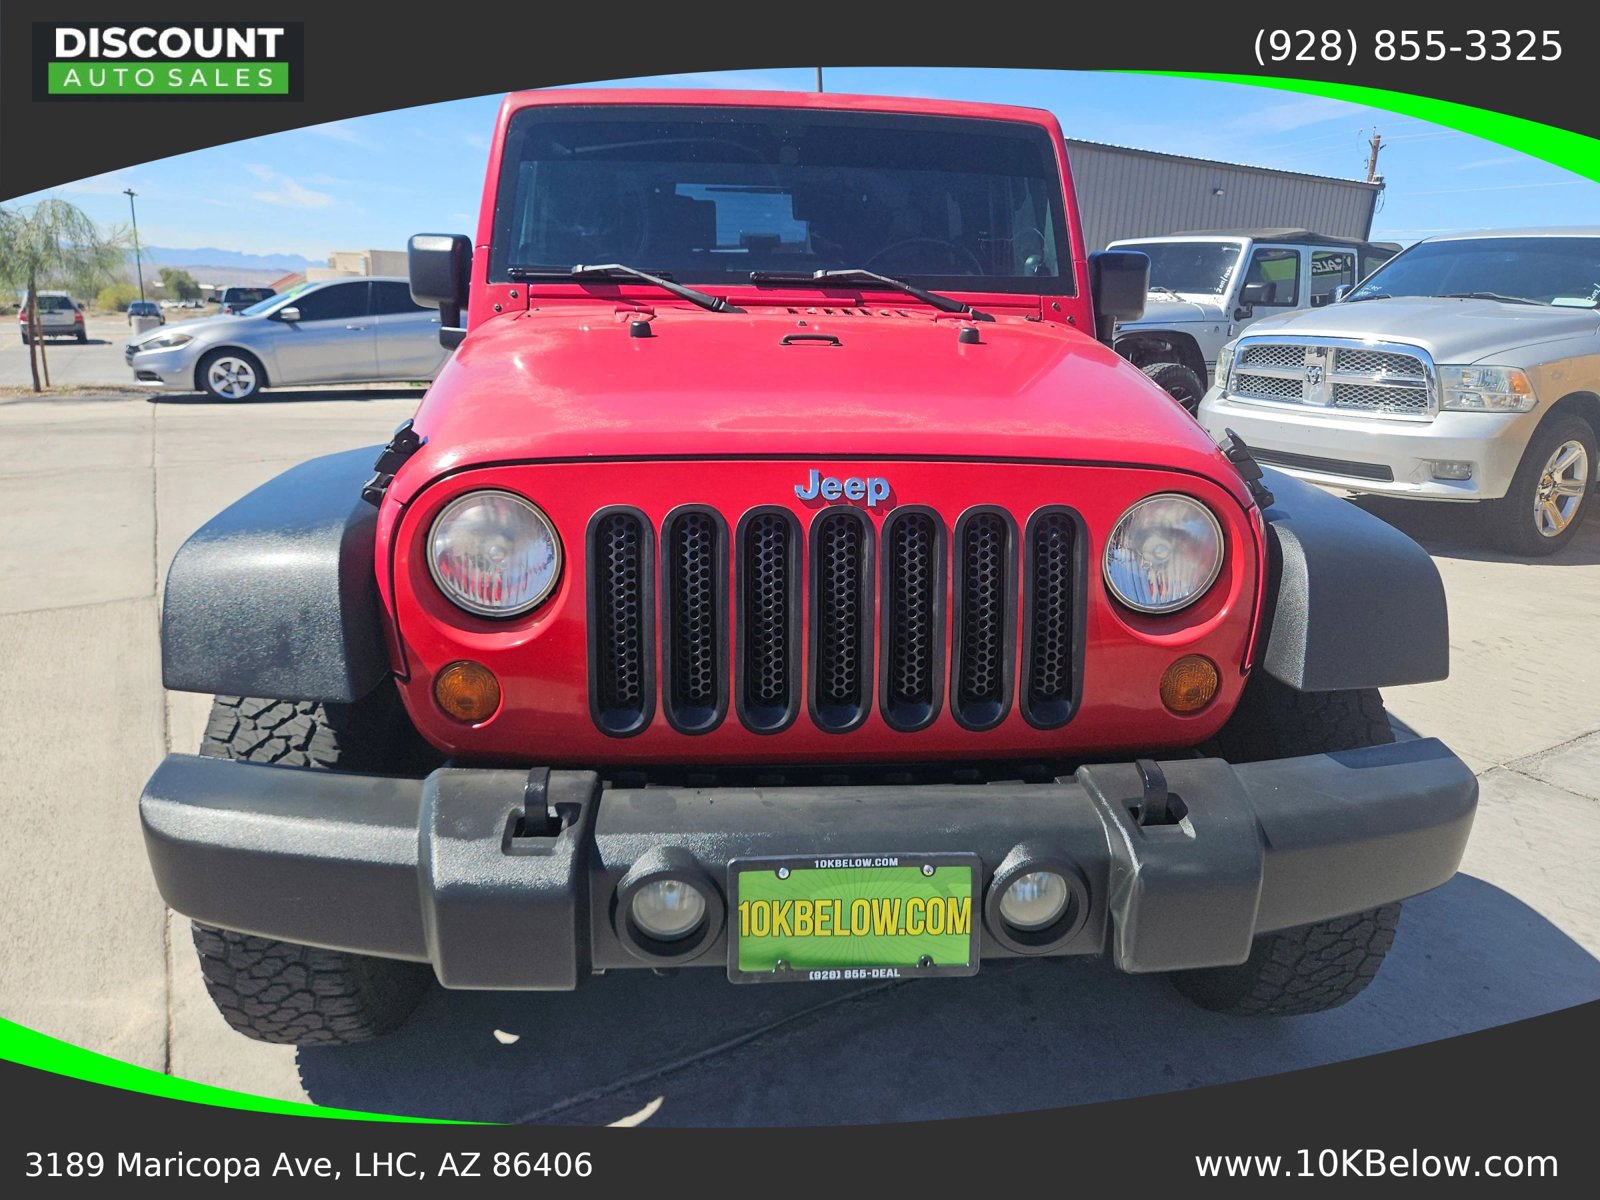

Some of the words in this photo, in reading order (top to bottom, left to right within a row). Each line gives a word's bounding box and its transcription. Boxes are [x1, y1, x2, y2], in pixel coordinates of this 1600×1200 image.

[794, 469, 891, 507] Jeep
[814, 857, 899, 869] 10KBELOW.COM
[738, 896, 971, 938] 10KBELOW.COM
[809, 970, 841, 980] (928)
[844, 968, 901, 979] 855-DEAL
